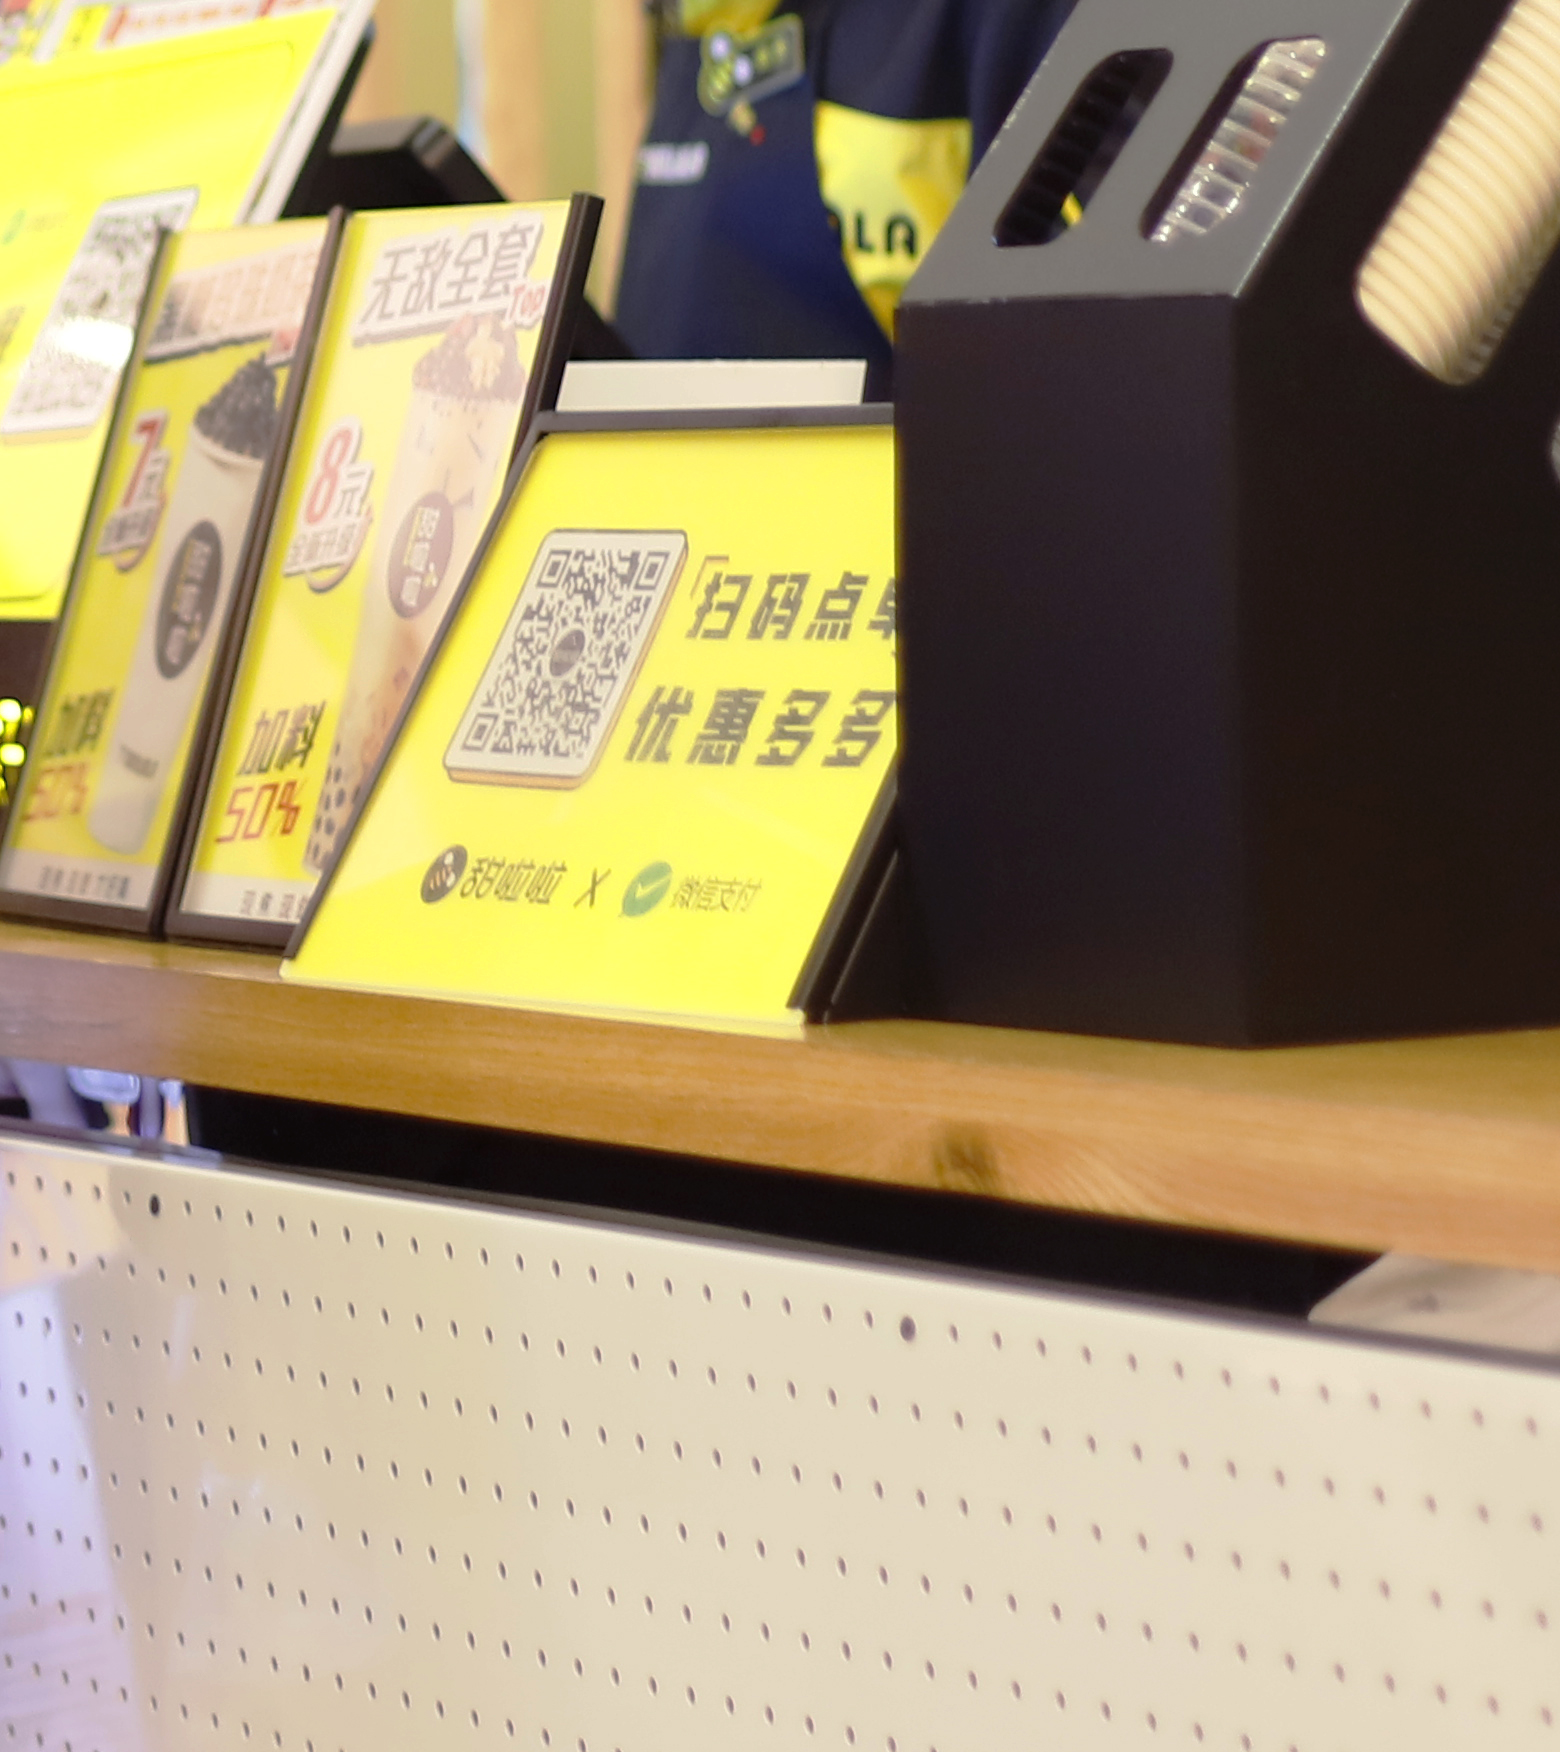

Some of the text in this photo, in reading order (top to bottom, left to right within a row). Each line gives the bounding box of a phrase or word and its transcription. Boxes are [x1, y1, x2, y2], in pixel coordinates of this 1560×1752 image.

[359, 221, 537, 325] 无敌全套
[236, 700, 326, 776] 加料
[624, 685, 897, 767] 优惠多多
[214, 776, 307, 842] 50%
[669, 874, 763, 913] 微信支付
